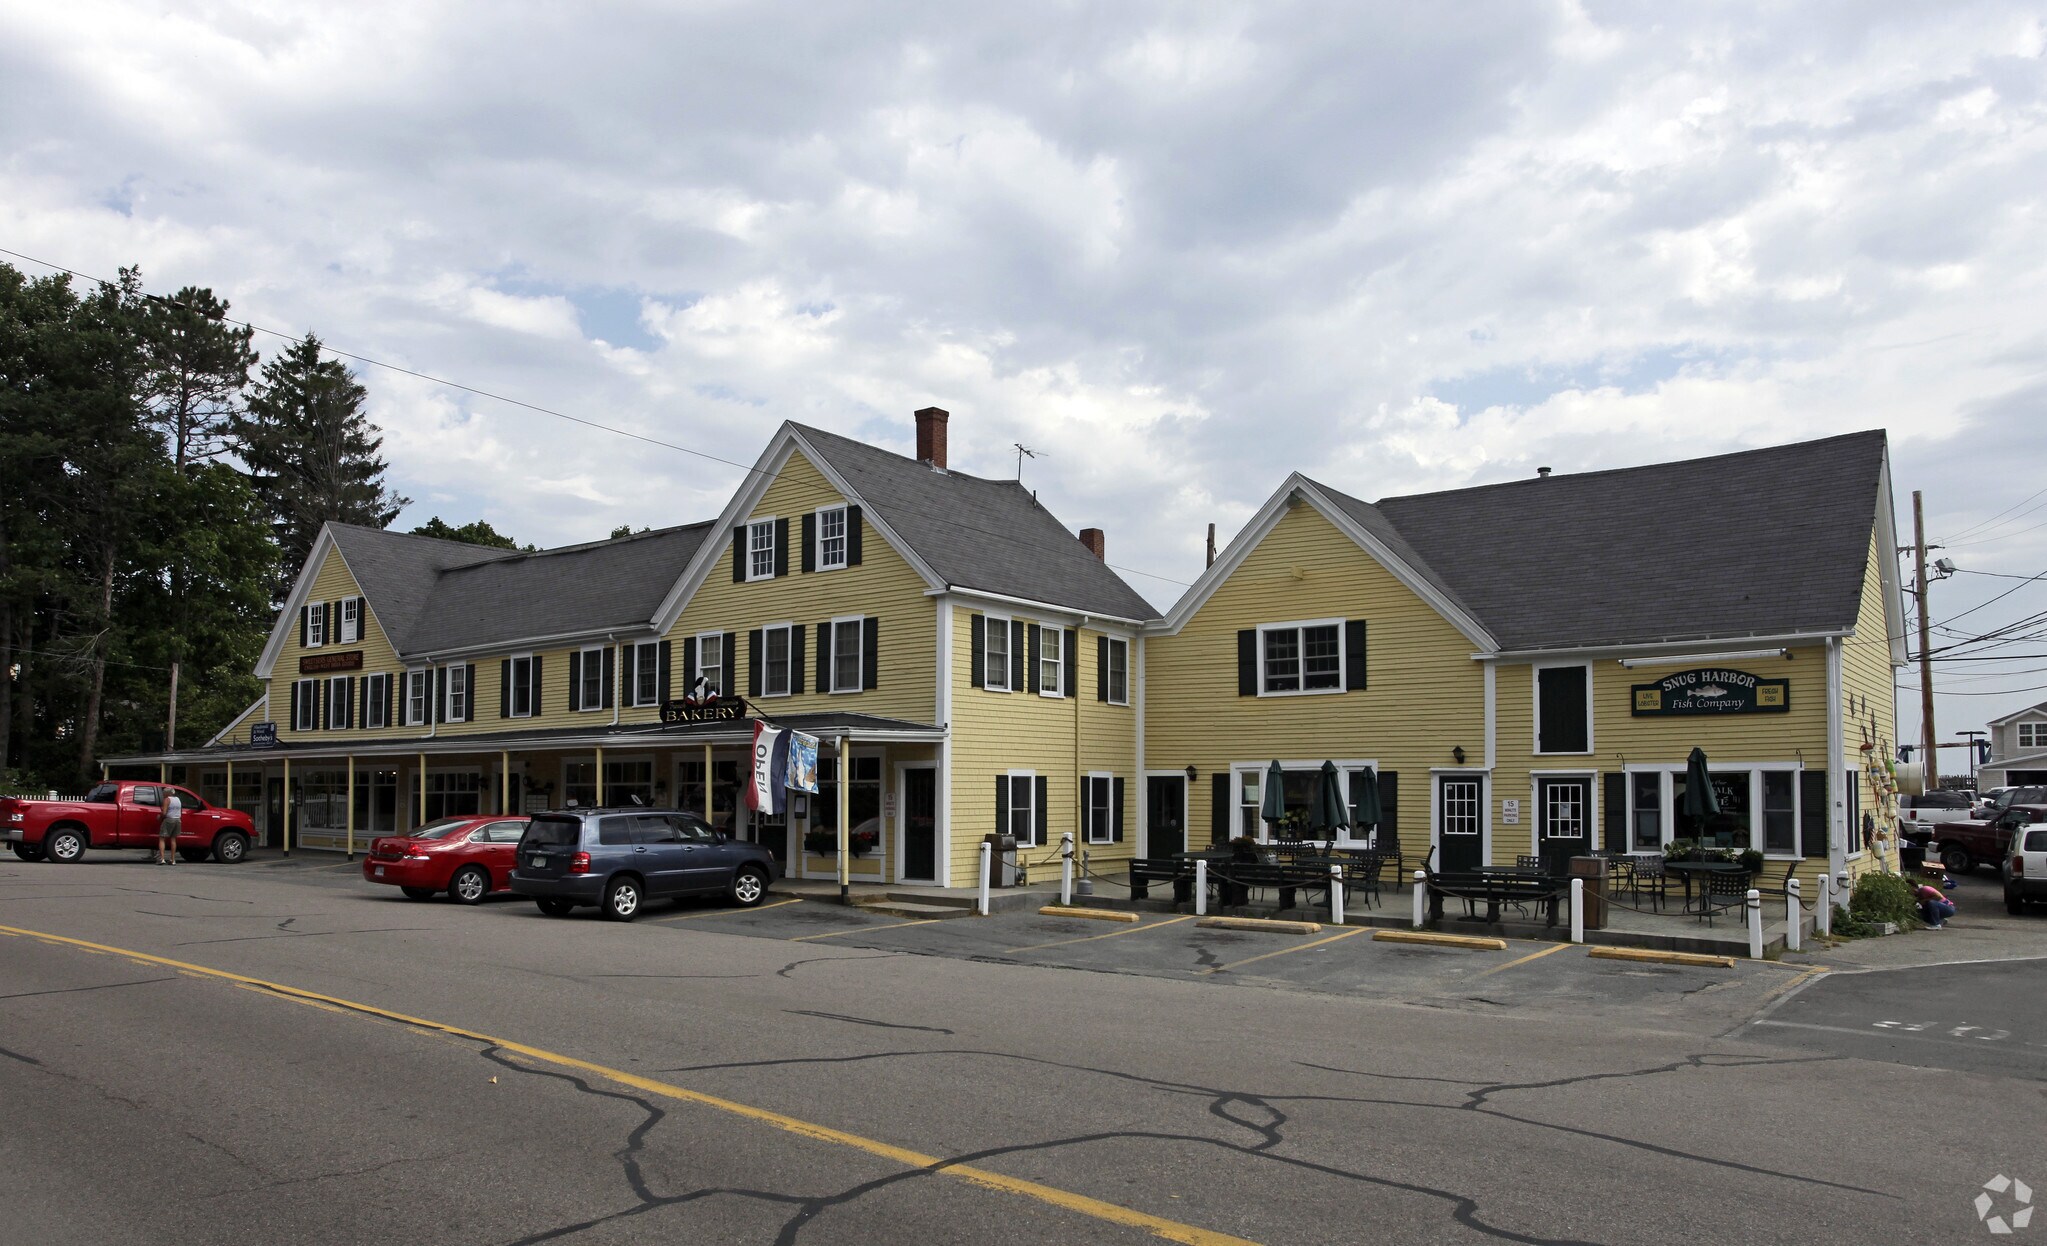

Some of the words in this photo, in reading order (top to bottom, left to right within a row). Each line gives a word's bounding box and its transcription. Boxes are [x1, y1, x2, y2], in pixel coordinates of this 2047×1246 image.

[1662, 673, 1696, 692] SNUG
[1701, 671, 1756, 688] HARBOR
[1761, 687, 1779, 695] FRESH
[1672, 699, 1693, 709] Fish
[1696, 699, 1745, 711] Company
[666, 706, 740, 722] BAKERY
